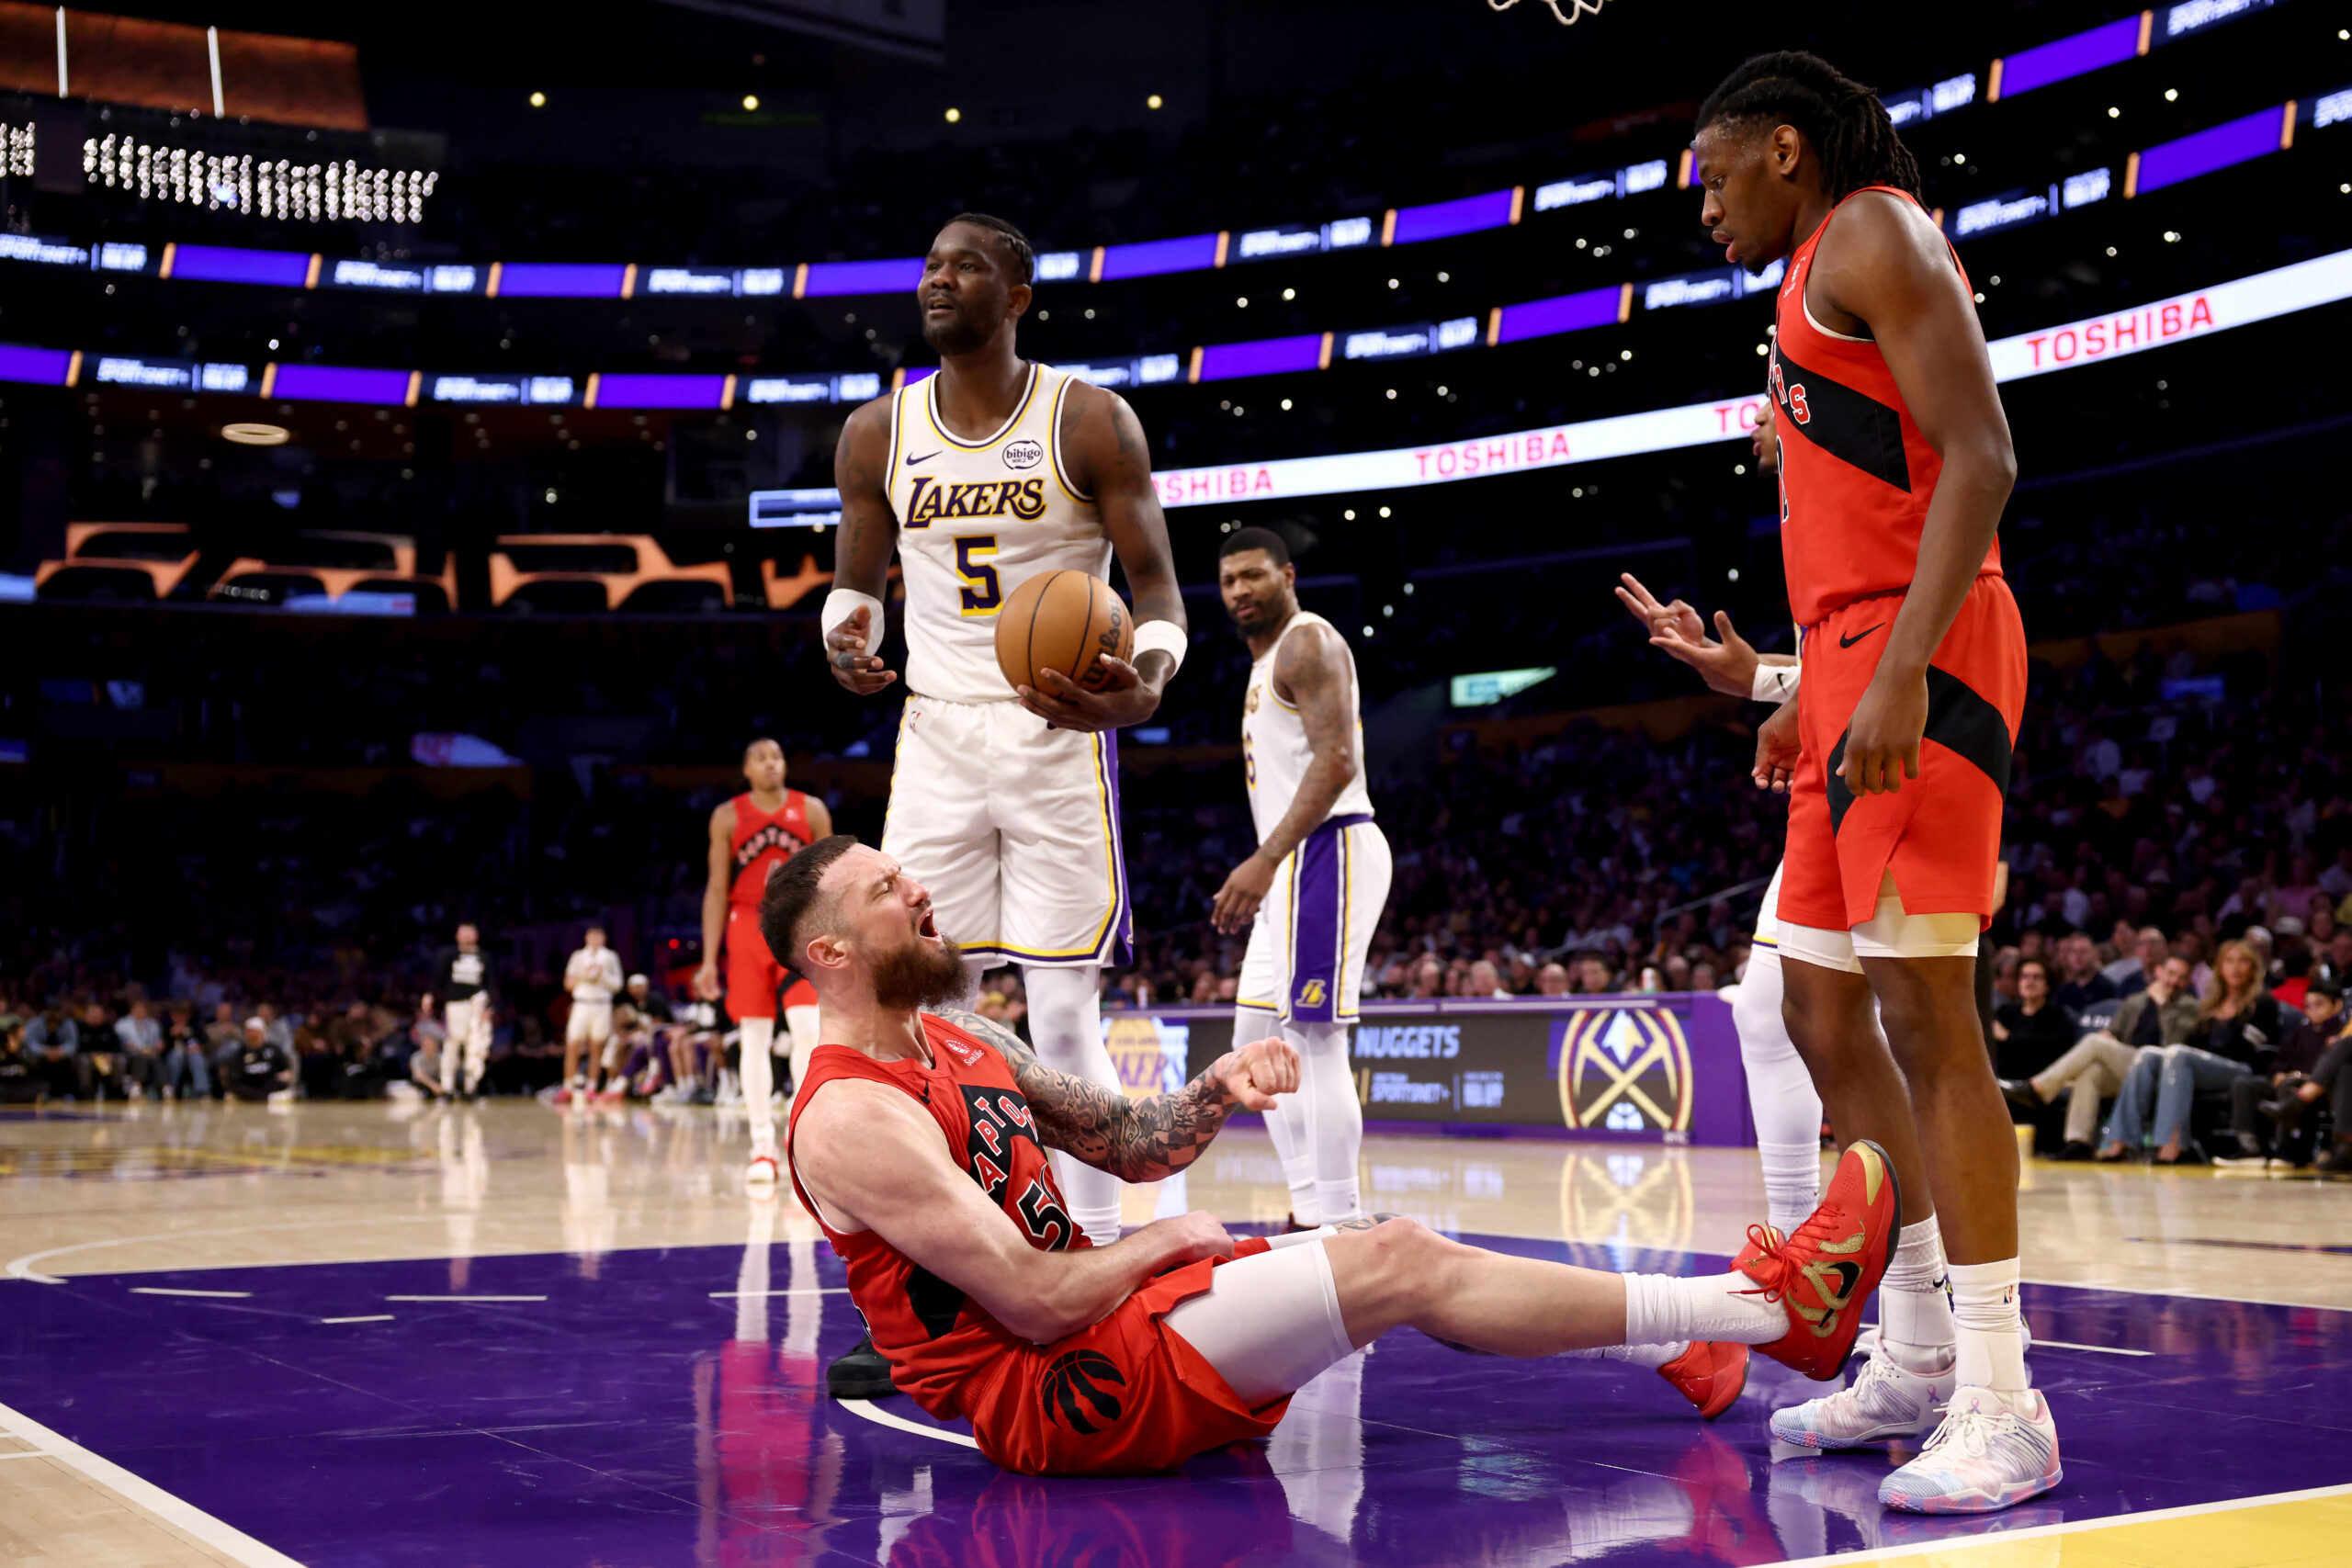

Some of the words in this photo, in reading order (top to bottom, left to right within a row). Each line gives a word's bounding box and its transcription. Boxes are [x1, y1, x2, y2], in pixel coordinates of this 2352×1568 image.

[2027, 297, 2213, 367] TOSHIBA
[1006, 447, 1041, 460] bibigo
[1415, 433, 1570, 478] TOSHIBA
[904, 476, 1048, 530] LAKERS
[1150, 468, 1273, 502] SHIBA
[953, 533, 1004, 617] 5
[738, 827, 808, 865] RAPTOR
[1354, 1024, 1462, 1058] NUGGETS
[973, 1095, 1039, 1195] APTO
[1016, 1161, 1073, 1252] 5
